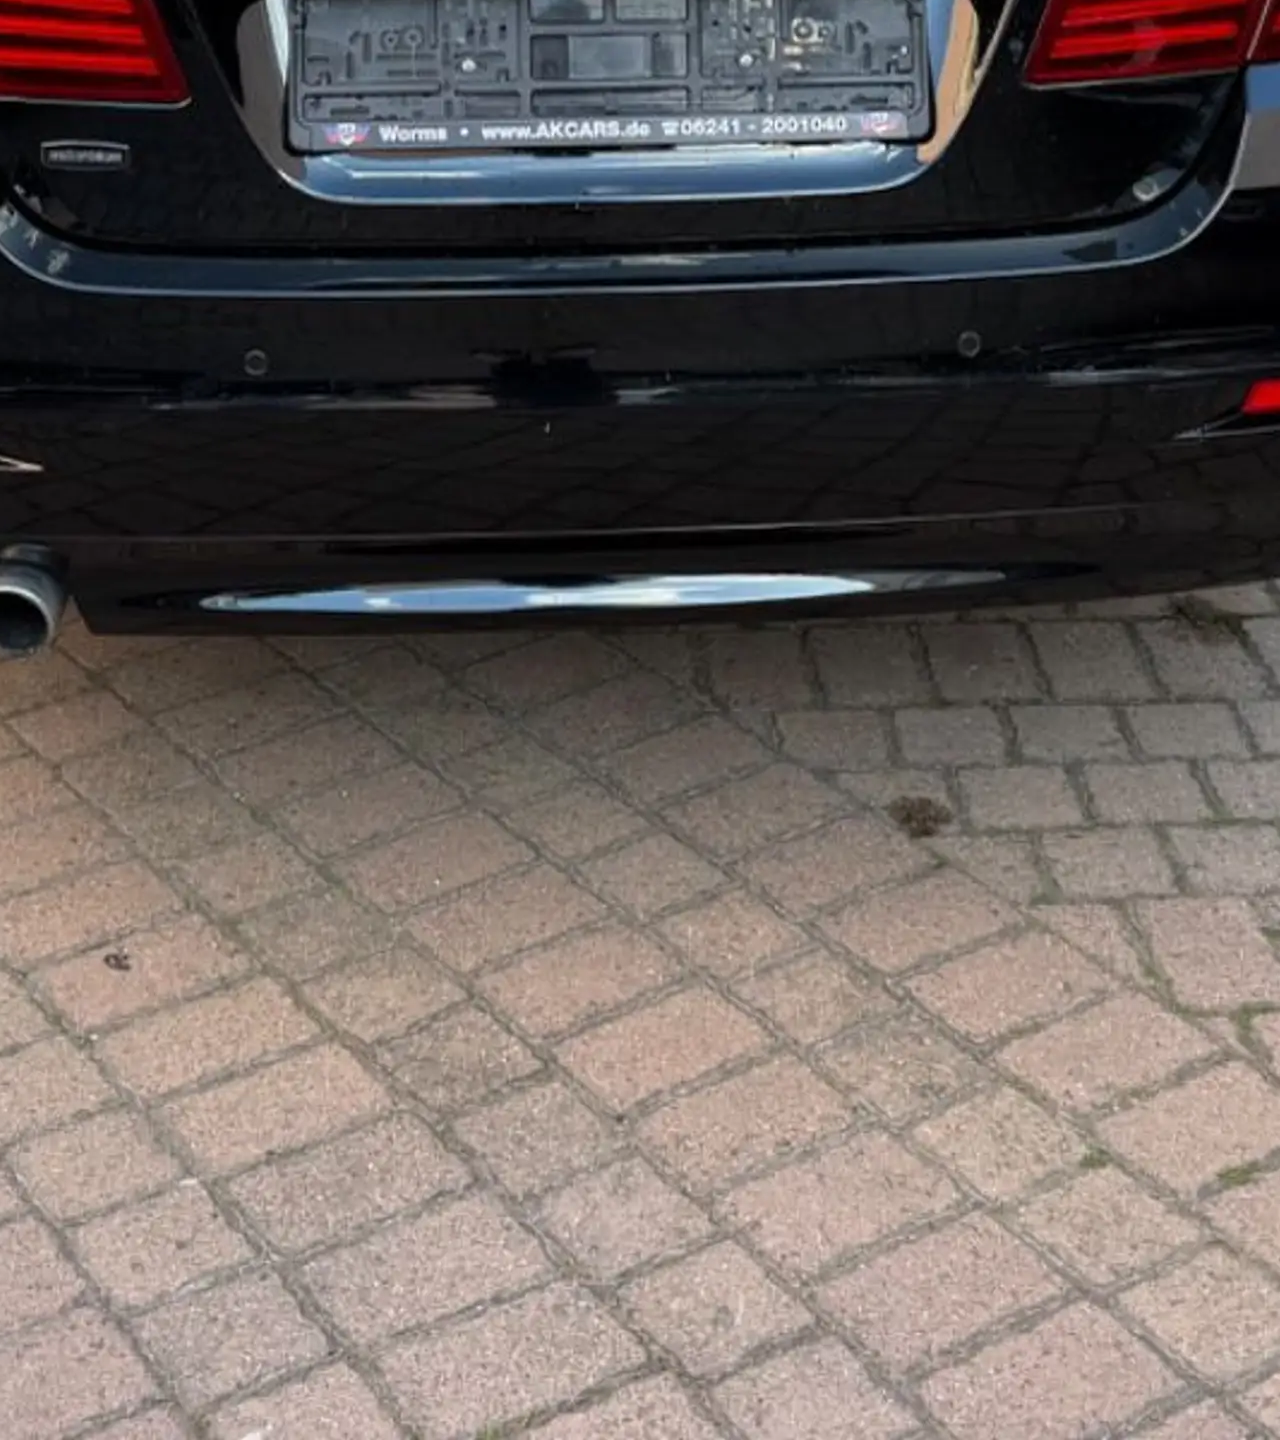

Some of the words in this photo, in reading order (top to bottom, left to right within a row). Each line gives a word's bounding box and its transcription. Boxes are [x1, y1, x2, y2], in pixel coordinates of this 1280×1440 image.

[378, 124, 448, 143] Worms
[481, 120, 651, 140] www.AKCARS.de
[680, 117, 741, 136] 06241
[761, 115, 848, 135] 2001040
